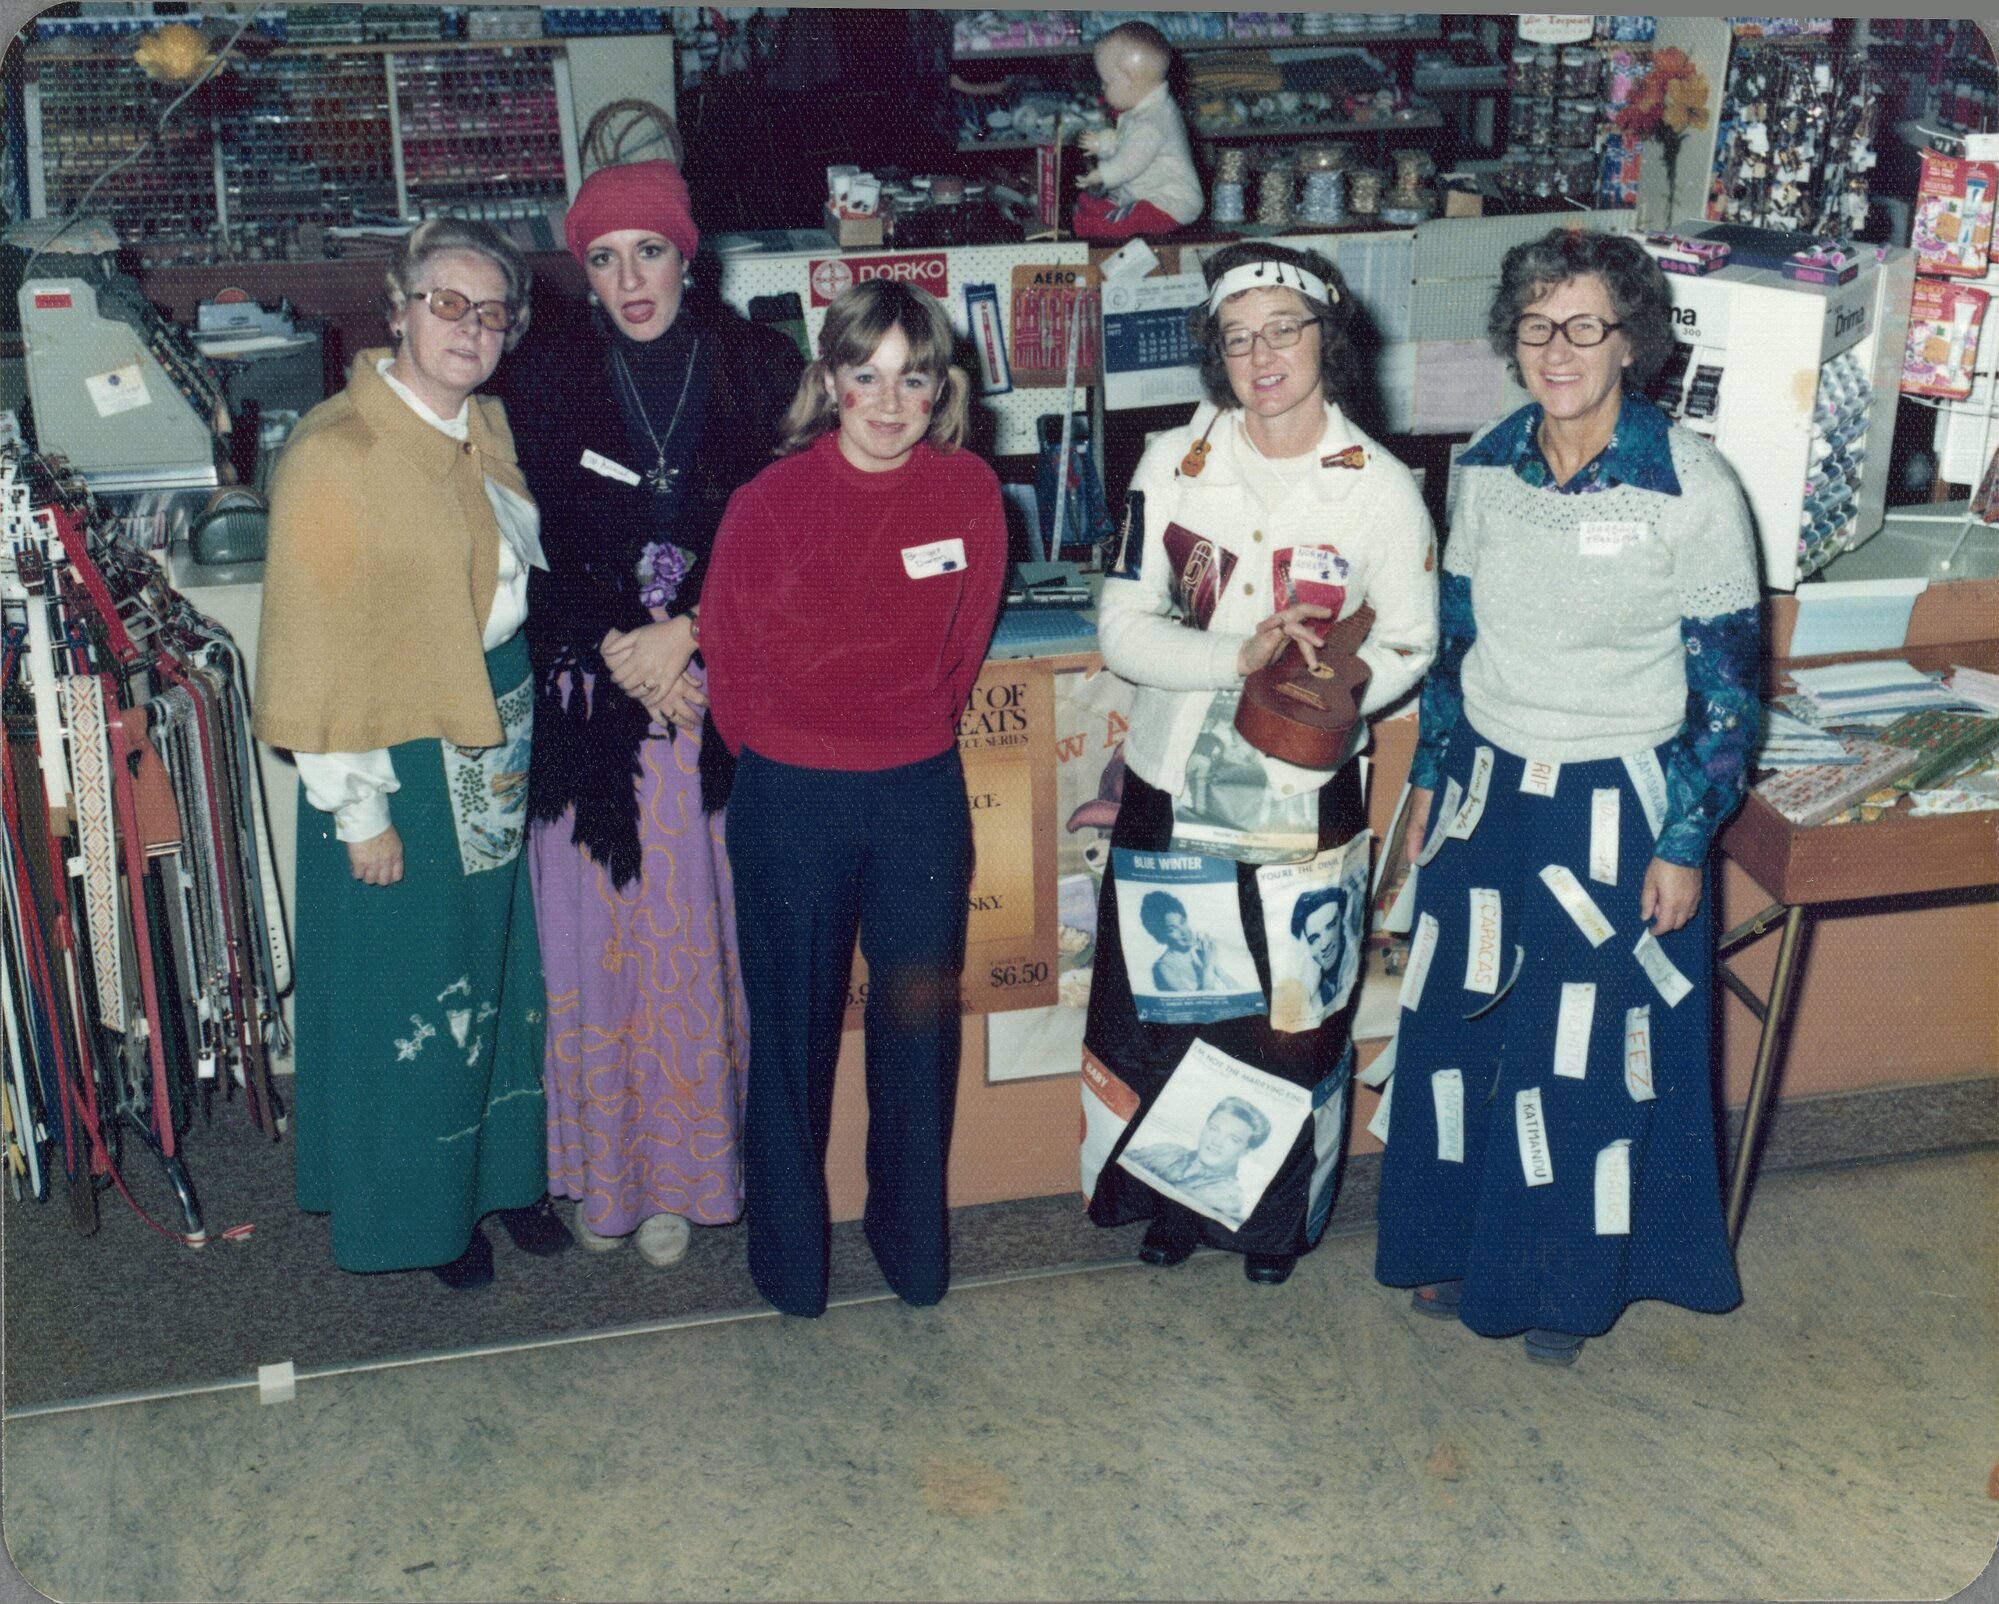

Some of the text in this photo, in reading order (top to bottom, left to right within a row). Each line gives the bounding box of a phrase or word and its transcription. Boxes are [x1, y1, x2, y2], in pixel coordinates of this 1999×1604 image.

[859, 259, 945, 284] DORKO
[1033, 271, 1076, 285] AERO
[1682, 327, 1702, 337] 300
[1297, 548, 1328, 559] NORMA
[986, 683, 1027, 709] OF
[985, 735, 1029, 747] SERIES
[1133, 855, 1202, 871] BLUE WINTER
[1260, 858, 1340, 881] YOU'RE THE DEVIL
[1475, 904, 1497, 985] CARACAS
[990, 961, 1049, 988] $6.50
[1206, 1053, 1226, 1068] NOT
[1225, 1064, 1240, 1076] THE
[1627, 1030, 1650, 1091] FEZ
[1085, 1061, 1109, 1088] BABY
[1523, 1102, 1547, 1178] KATMANDU
